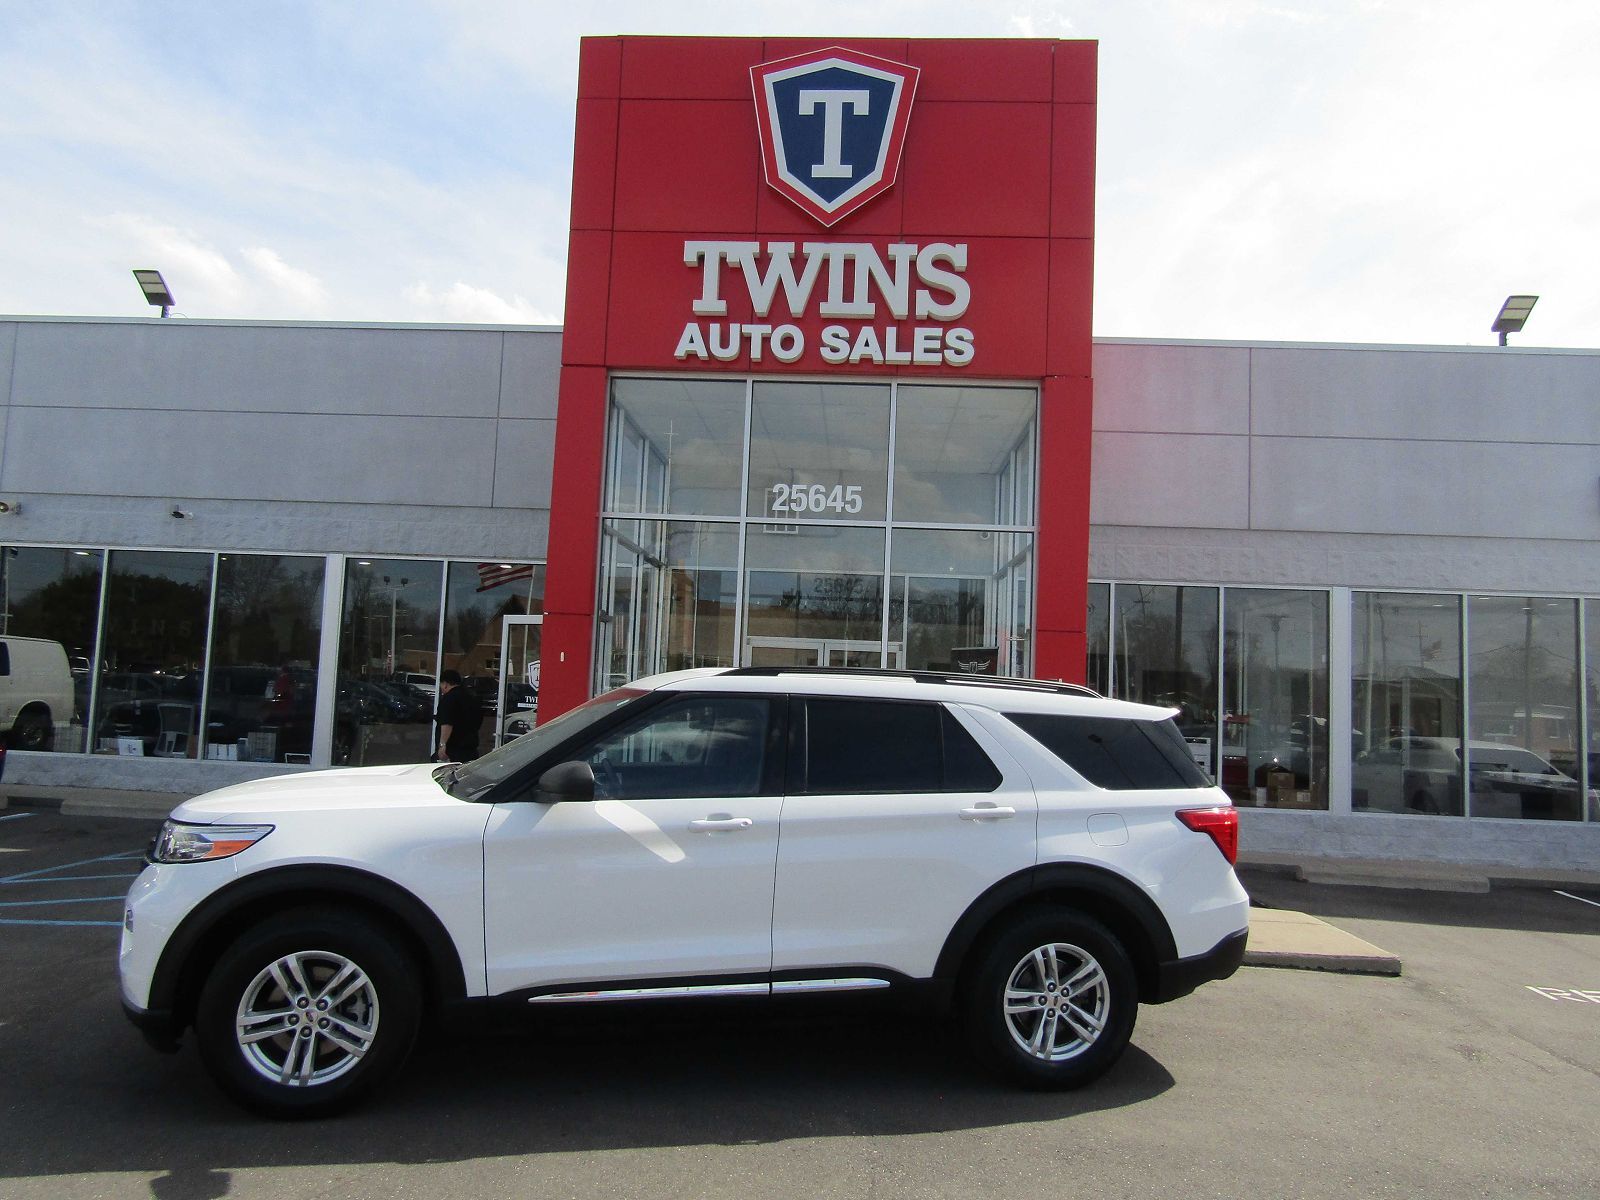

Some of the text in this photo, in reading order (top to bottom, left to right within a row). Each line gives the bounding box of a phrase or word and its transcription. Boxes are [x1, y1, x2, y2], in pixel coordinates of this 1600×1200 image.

[798, 89, 870, 178] T
[683, 240, 971, 321] TWINS
[674, 322, 975, 366] AUTO SALES
[772, 483, 863, 513] 25645
[525, 695, 538, 703] TWI
